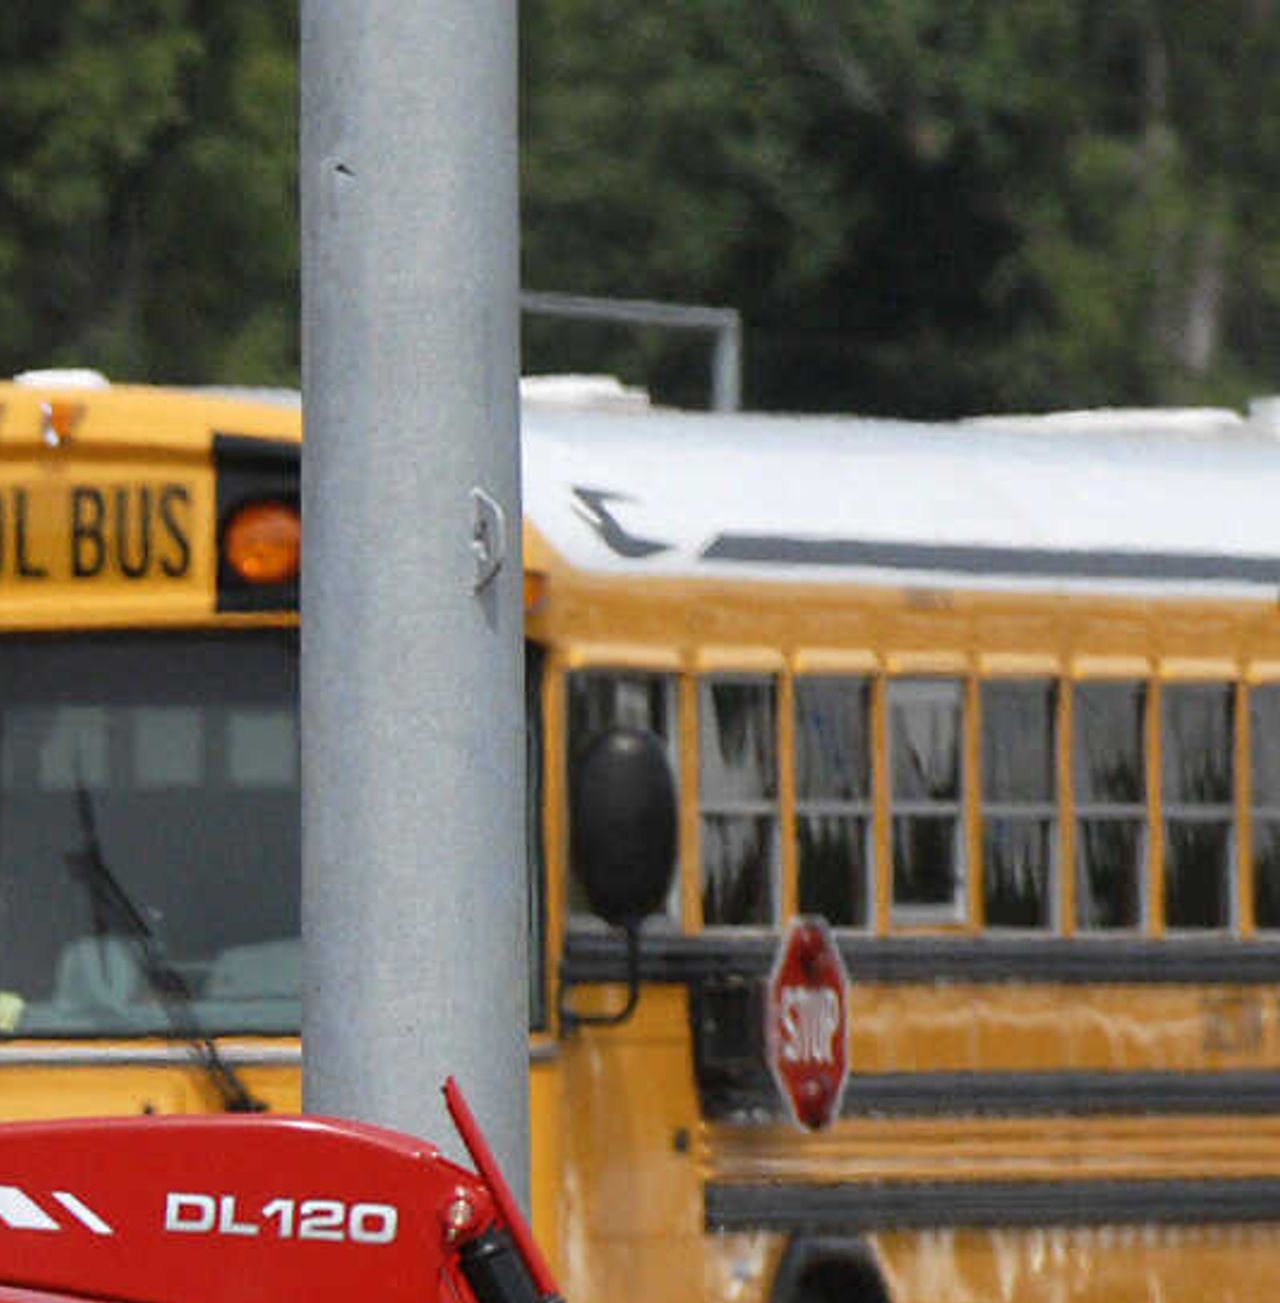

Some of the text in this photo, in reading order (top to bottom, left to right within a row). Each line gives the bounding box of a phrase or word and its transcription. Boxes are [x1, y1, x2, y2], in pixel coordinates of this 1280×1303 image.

[71, 484, 192, 579] BUS
[780, 986, 839, 1063] STOP
[165, 1192, 399, 1243] DL120
